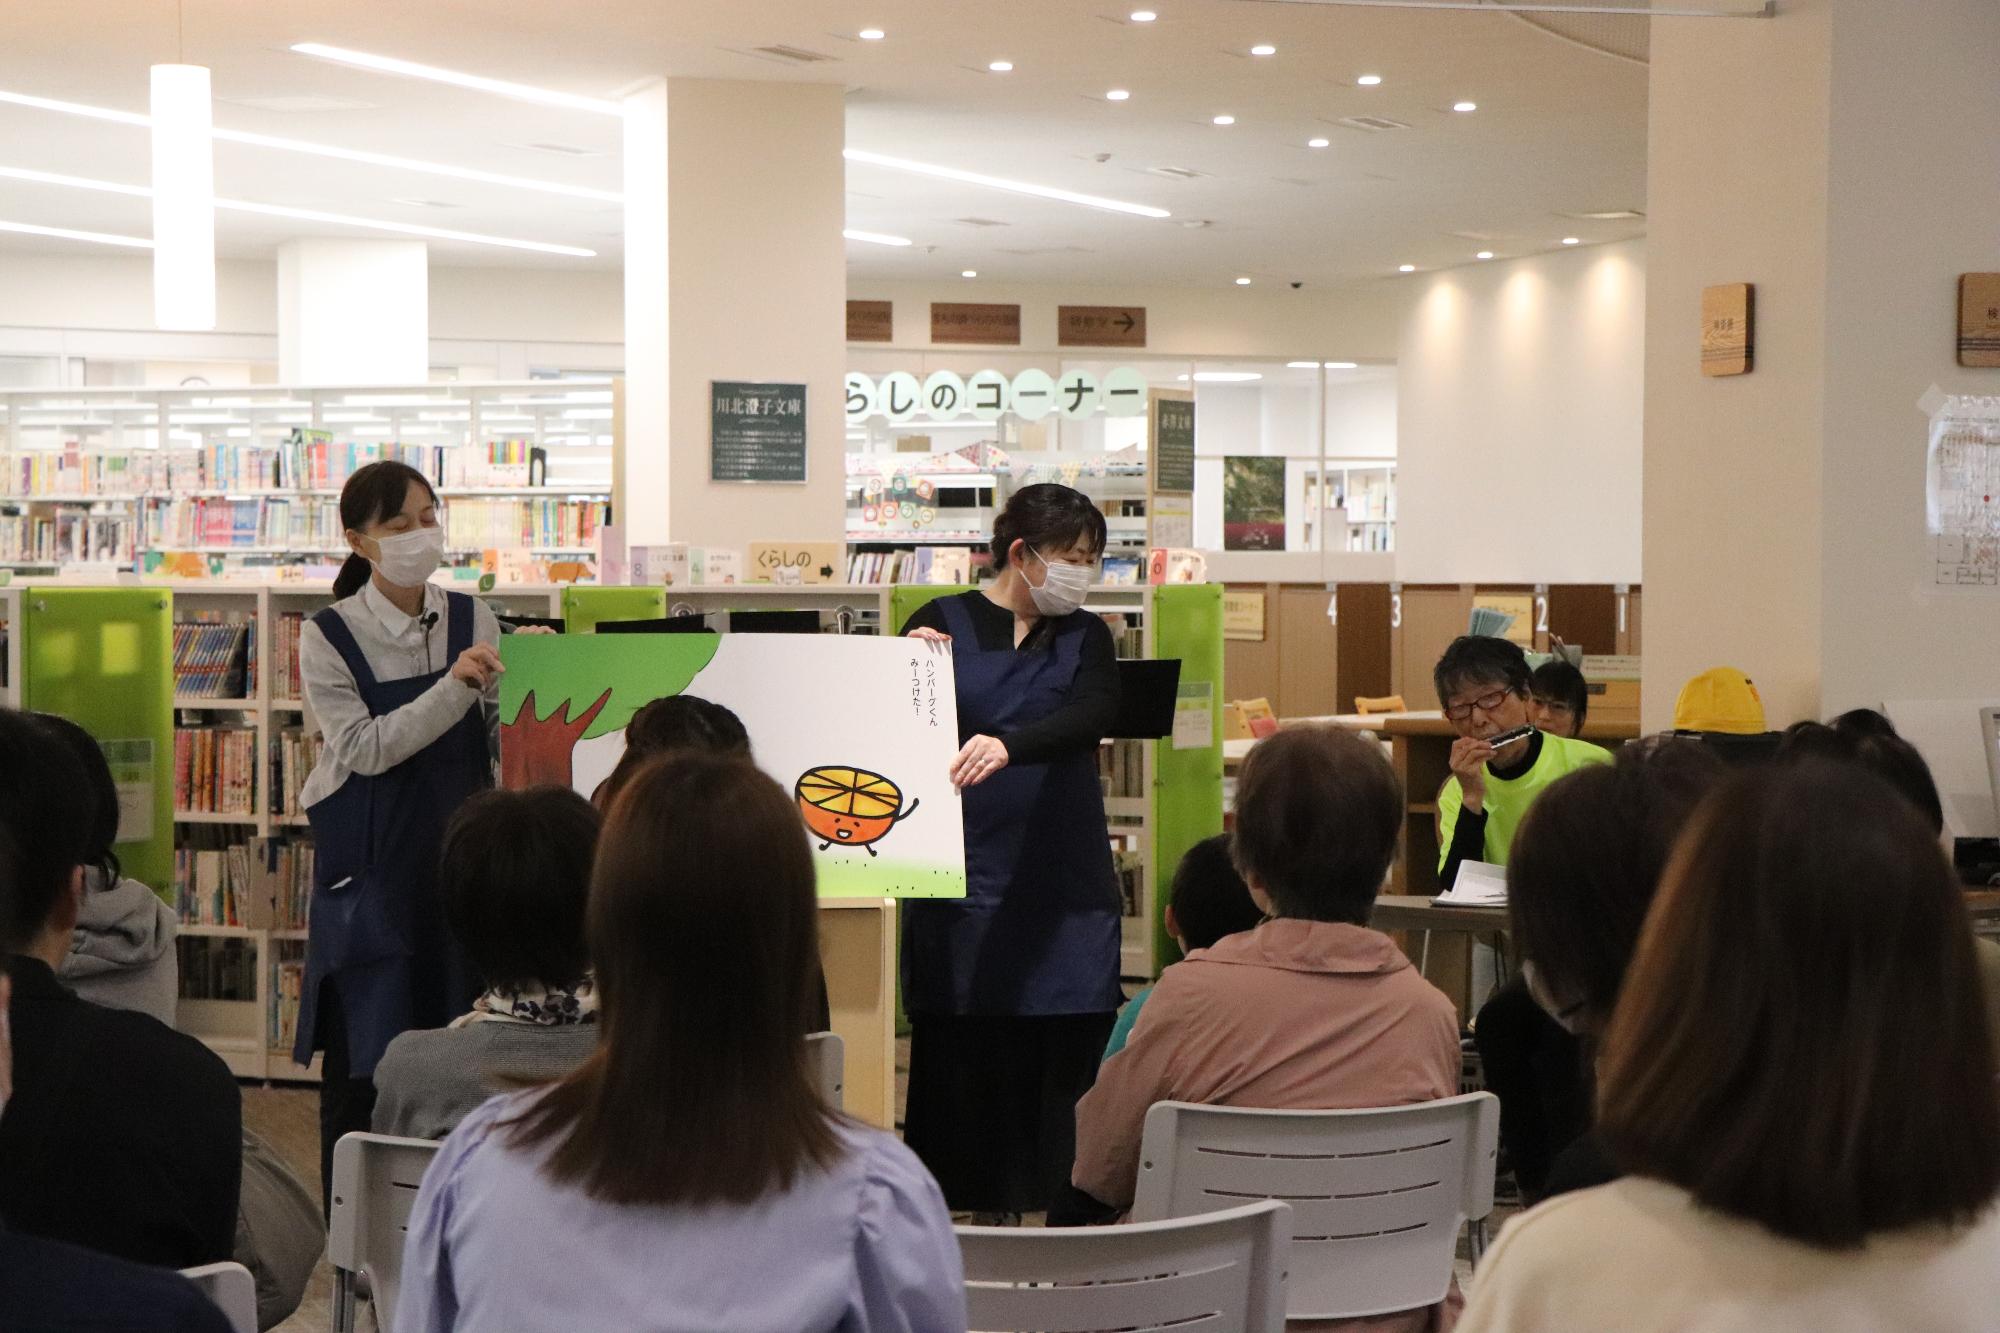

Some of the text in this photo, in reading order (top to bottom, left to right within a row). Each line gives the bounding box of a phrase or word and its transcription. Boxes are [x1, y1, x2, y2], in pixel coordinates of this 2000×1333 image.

[845, 377, 1139, 415] らしのコーナー
[757, 550, 812, 568] くらしの
[1326, 594, 1338, 626] 4
[1391, 594, 1402, 628] 3
[1536, 597, 1549, 632] 2
[1620, 597, 1625, 632] 1
[910, 658, 921, 717] みーつけた！
[925, 659, 939, 727] ハンバーグくん
